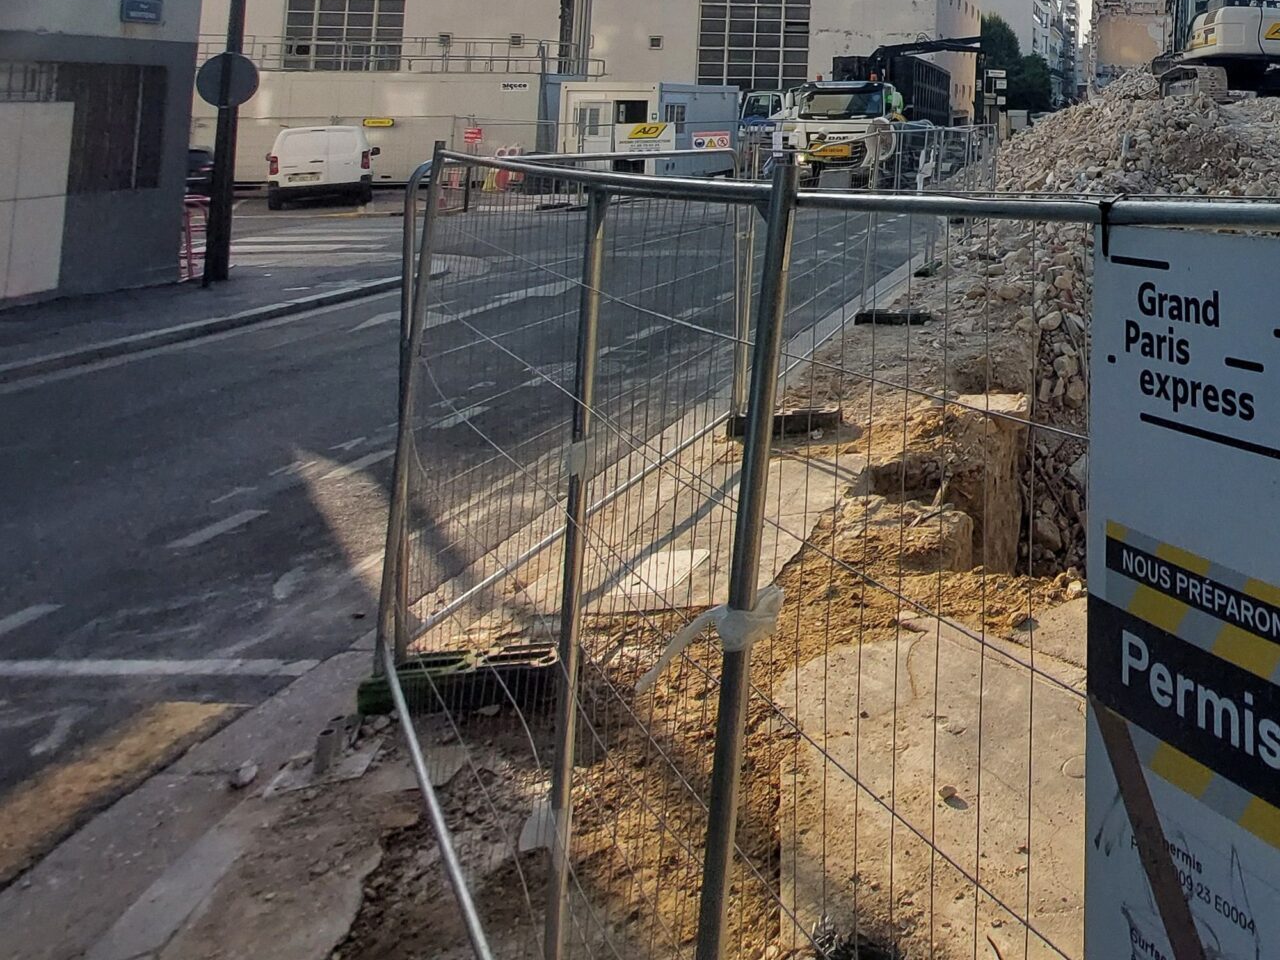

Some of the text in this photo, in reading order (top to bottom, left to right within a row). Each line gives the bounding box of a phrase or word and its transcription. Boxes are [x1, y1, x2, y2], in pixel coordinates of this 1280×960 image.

[1137, 281, 1220, 328] Grand
[1125, 319, 1190, 366] Paris
[1139, 369, 1255, 421] express
[1122, 548, 1172, 589] NOUS
[1196, 882, 1212, 905] 23
